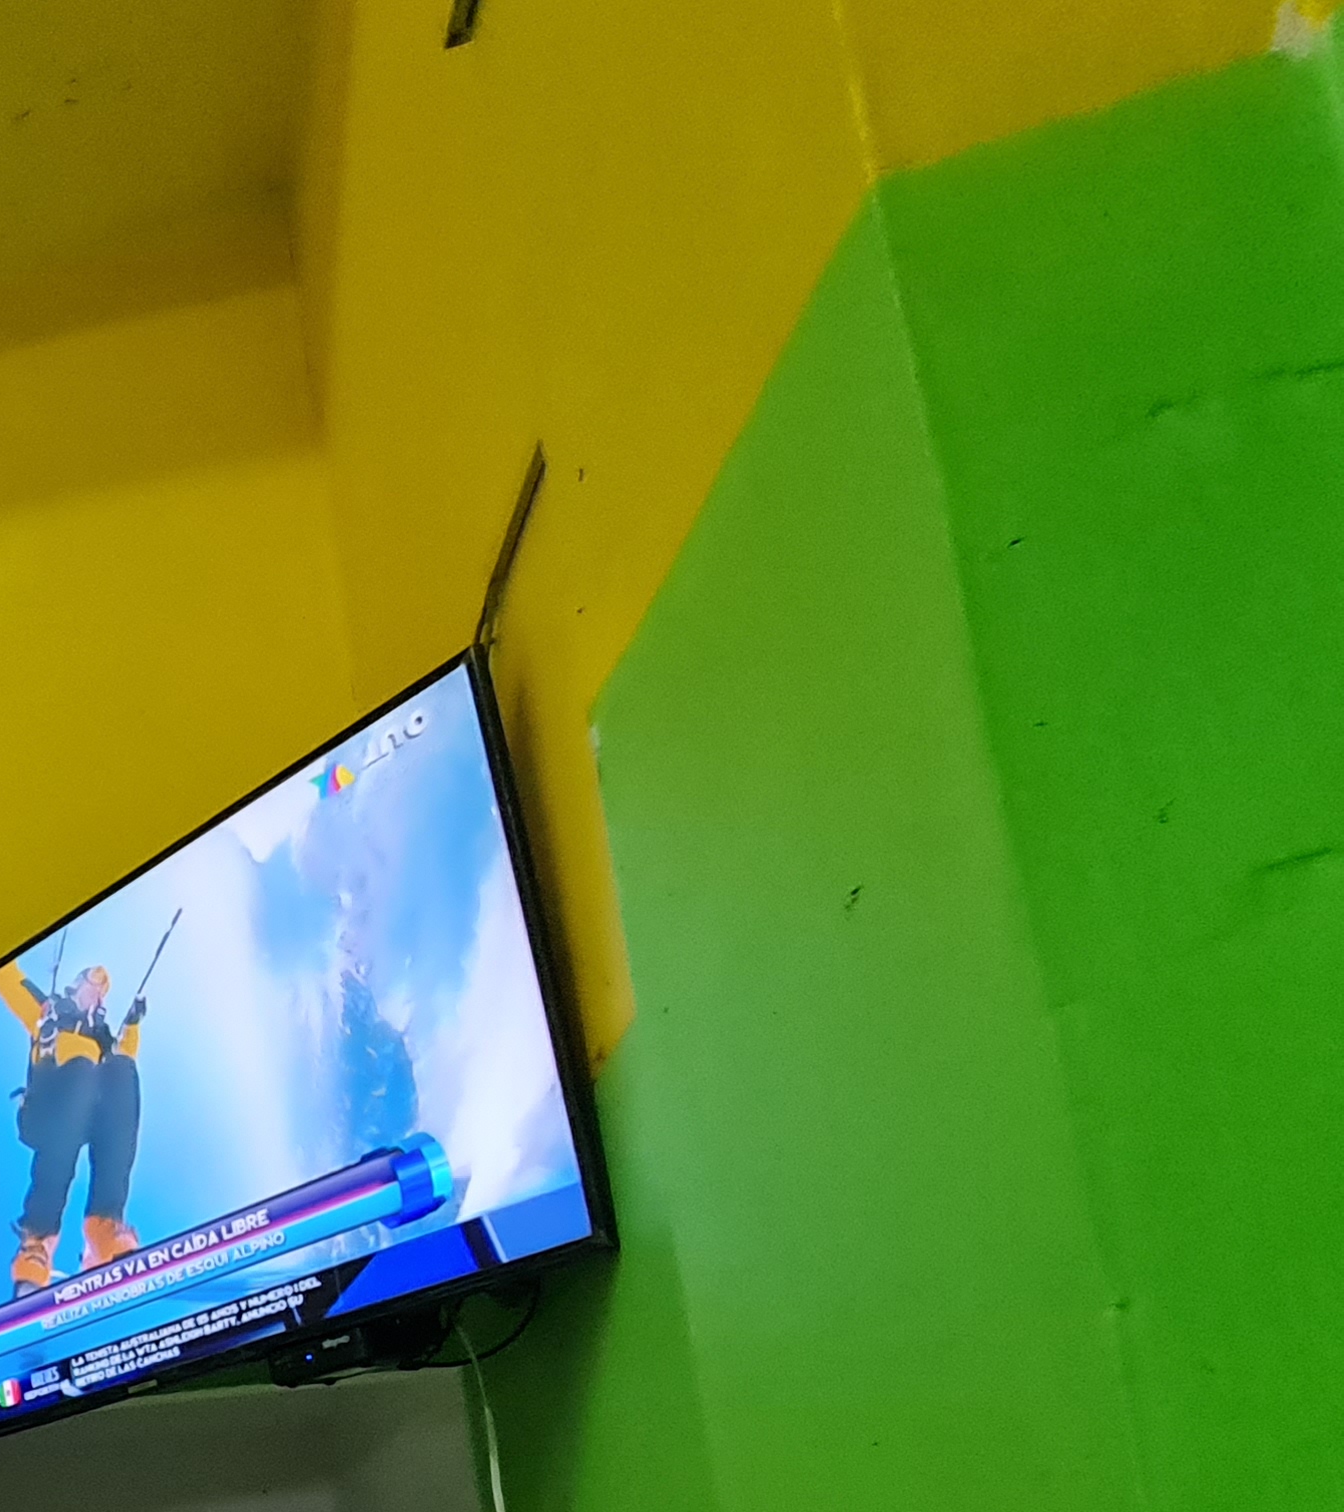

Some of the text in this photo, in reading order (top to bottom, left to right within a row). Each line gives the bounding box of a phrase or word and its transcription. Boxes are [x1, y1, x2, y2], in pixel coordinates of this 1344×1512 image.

[54, 1266, 123, 1304] MIENTRAS
[125, 1257, 148, 1279] VA
[148, 1250, 170, 1268] EN
[221, 1208, 271, 1240] LIBRE
[92, 1275, 165, 1311] MANIOBRAS
[166, 1268, 185, 1286] DE
[232, 1231, 286, 1261] ALPINO
[71, 1356, 85, 1367] LA
